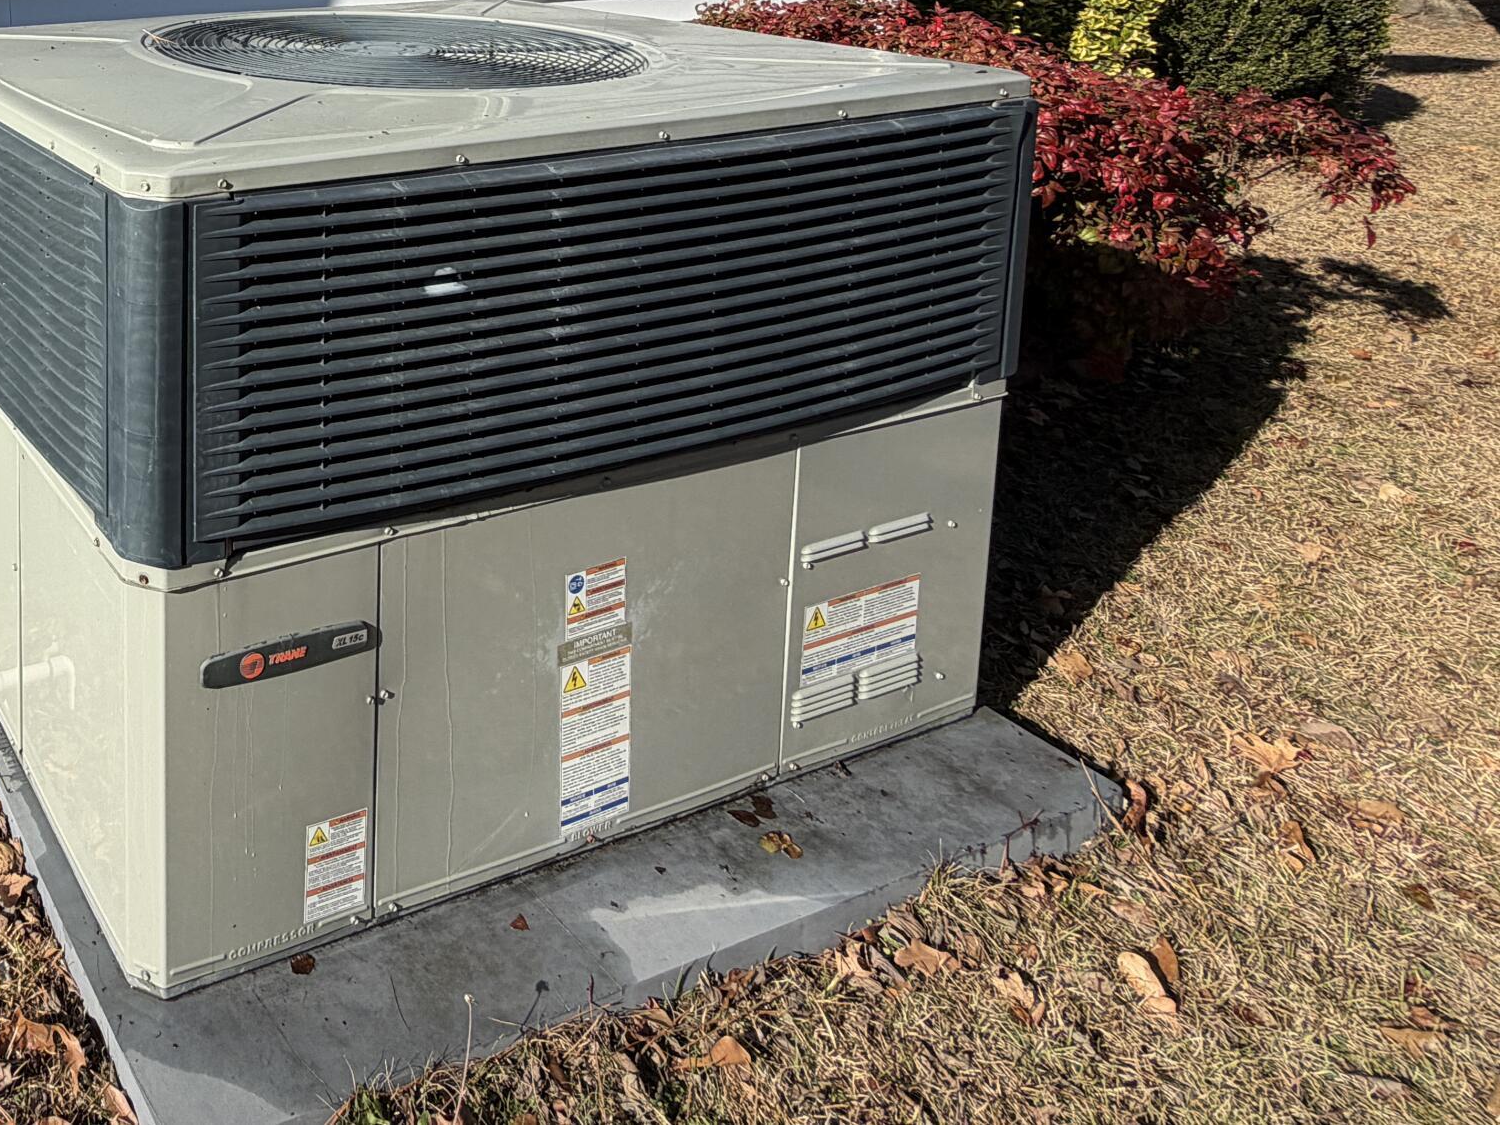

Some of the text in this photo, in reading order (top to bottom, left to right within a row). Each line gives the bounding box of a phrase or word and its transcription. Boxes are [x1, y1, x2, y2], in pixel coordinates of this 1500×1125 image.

[336, 636, 348, 648] XL
[573, 629, 616, 648] IMPORTANT
[268, 645, 308, 665] TRANE
[570, 821, 612, 841] BLOWER
[228, 923, 316, 961] COMPRESSOR
